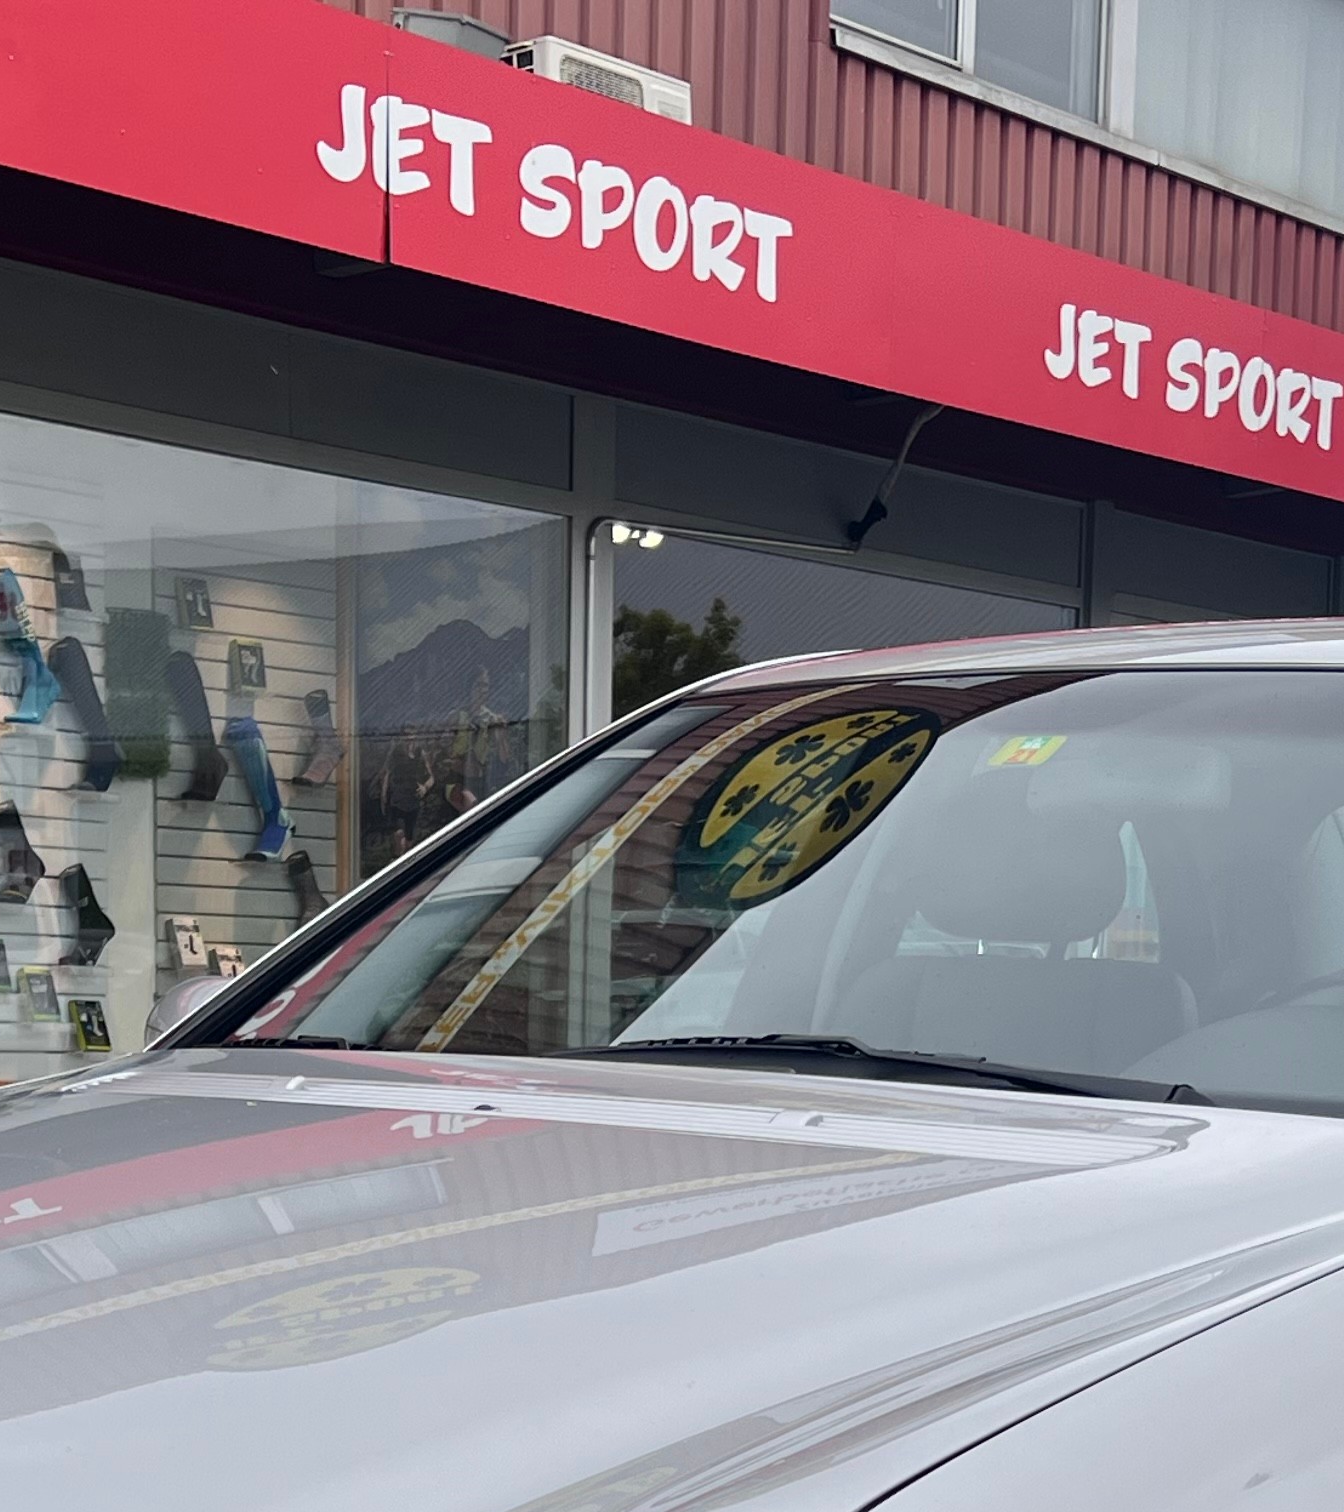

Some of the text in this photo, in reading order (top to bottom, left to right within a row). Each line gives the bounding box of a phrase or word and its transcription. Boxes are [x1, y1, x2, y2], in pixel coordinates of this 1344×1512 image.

[317, 84, 793, 303] JET SPORT
[1044, 303, 1343, 450] JET SPORT
